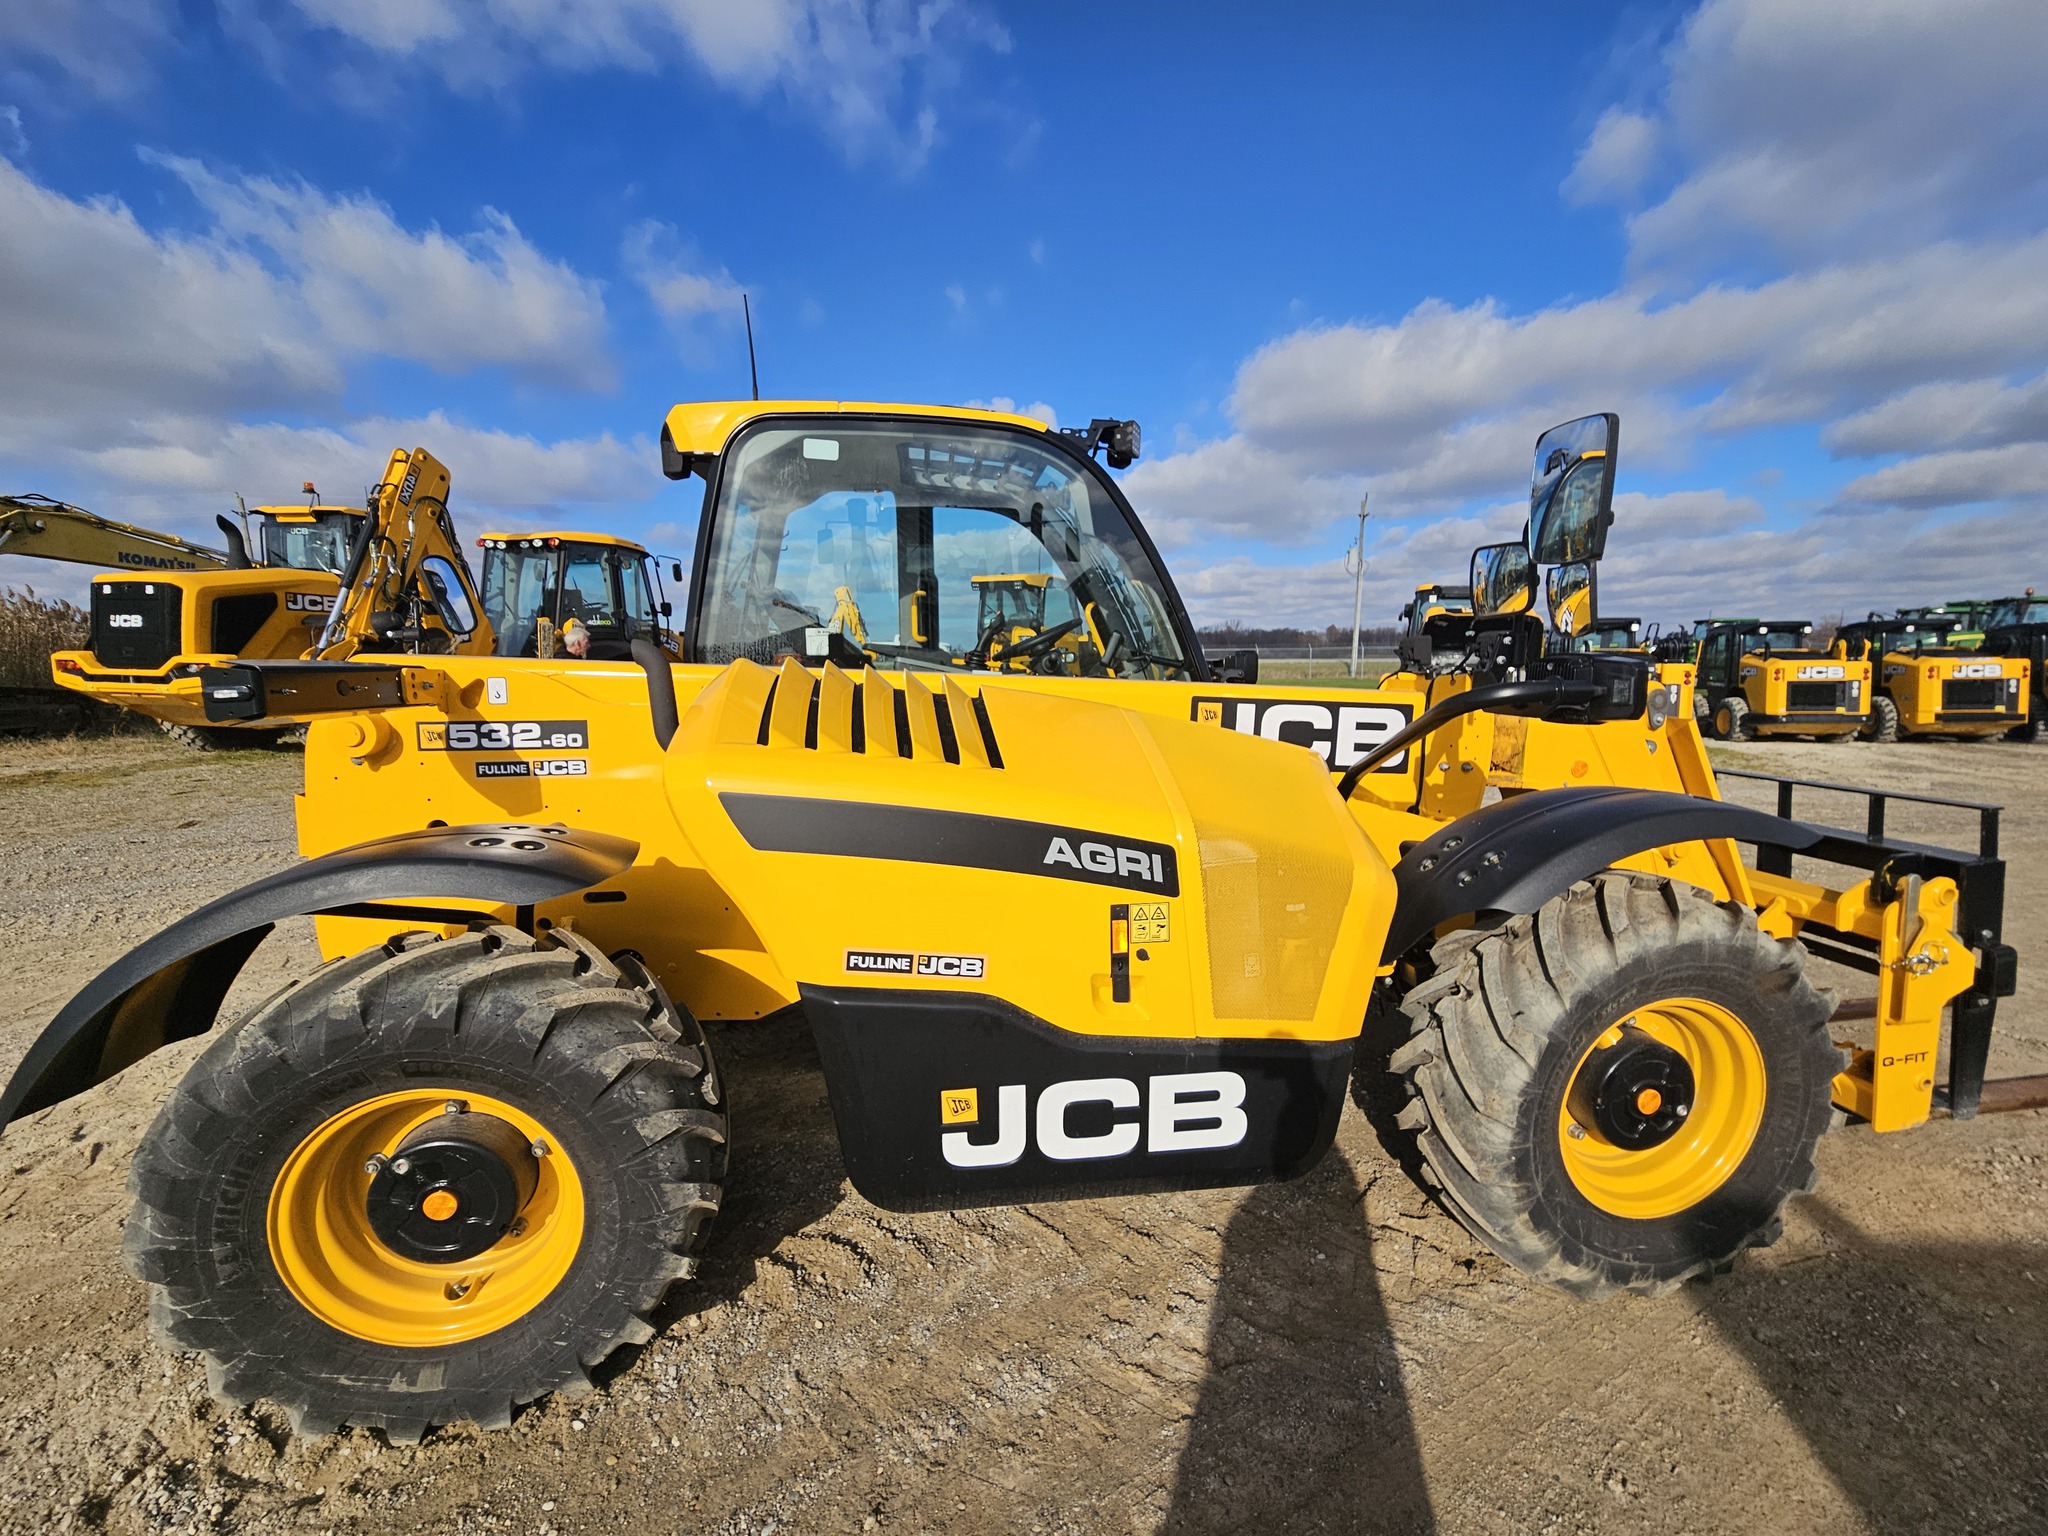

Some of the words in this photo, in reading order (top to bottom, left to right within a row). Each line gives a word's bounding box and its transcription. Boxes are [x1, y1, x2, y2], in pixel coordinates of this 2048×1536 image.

[118, 552, 196, 569] KOMATSU
[110, 614, 143, 628] JCB
[1798, 666, 1844, 678] JCB
[1953, 664, 2002, 678] JCB
[478, 764, 528, 775] FULLINE
[534, 760, 586, 776] JCB
[1043, 836, 1163, 883] AGRI
[849, 955, 911, 971] FULLINE
[918, 956, 983, 977] JCB
[1882, 1050, 1929, 1067] Q-FIT
[951, 1097, 972, 1114] JCB
[941, 1071, 1248, 1168] JCB
